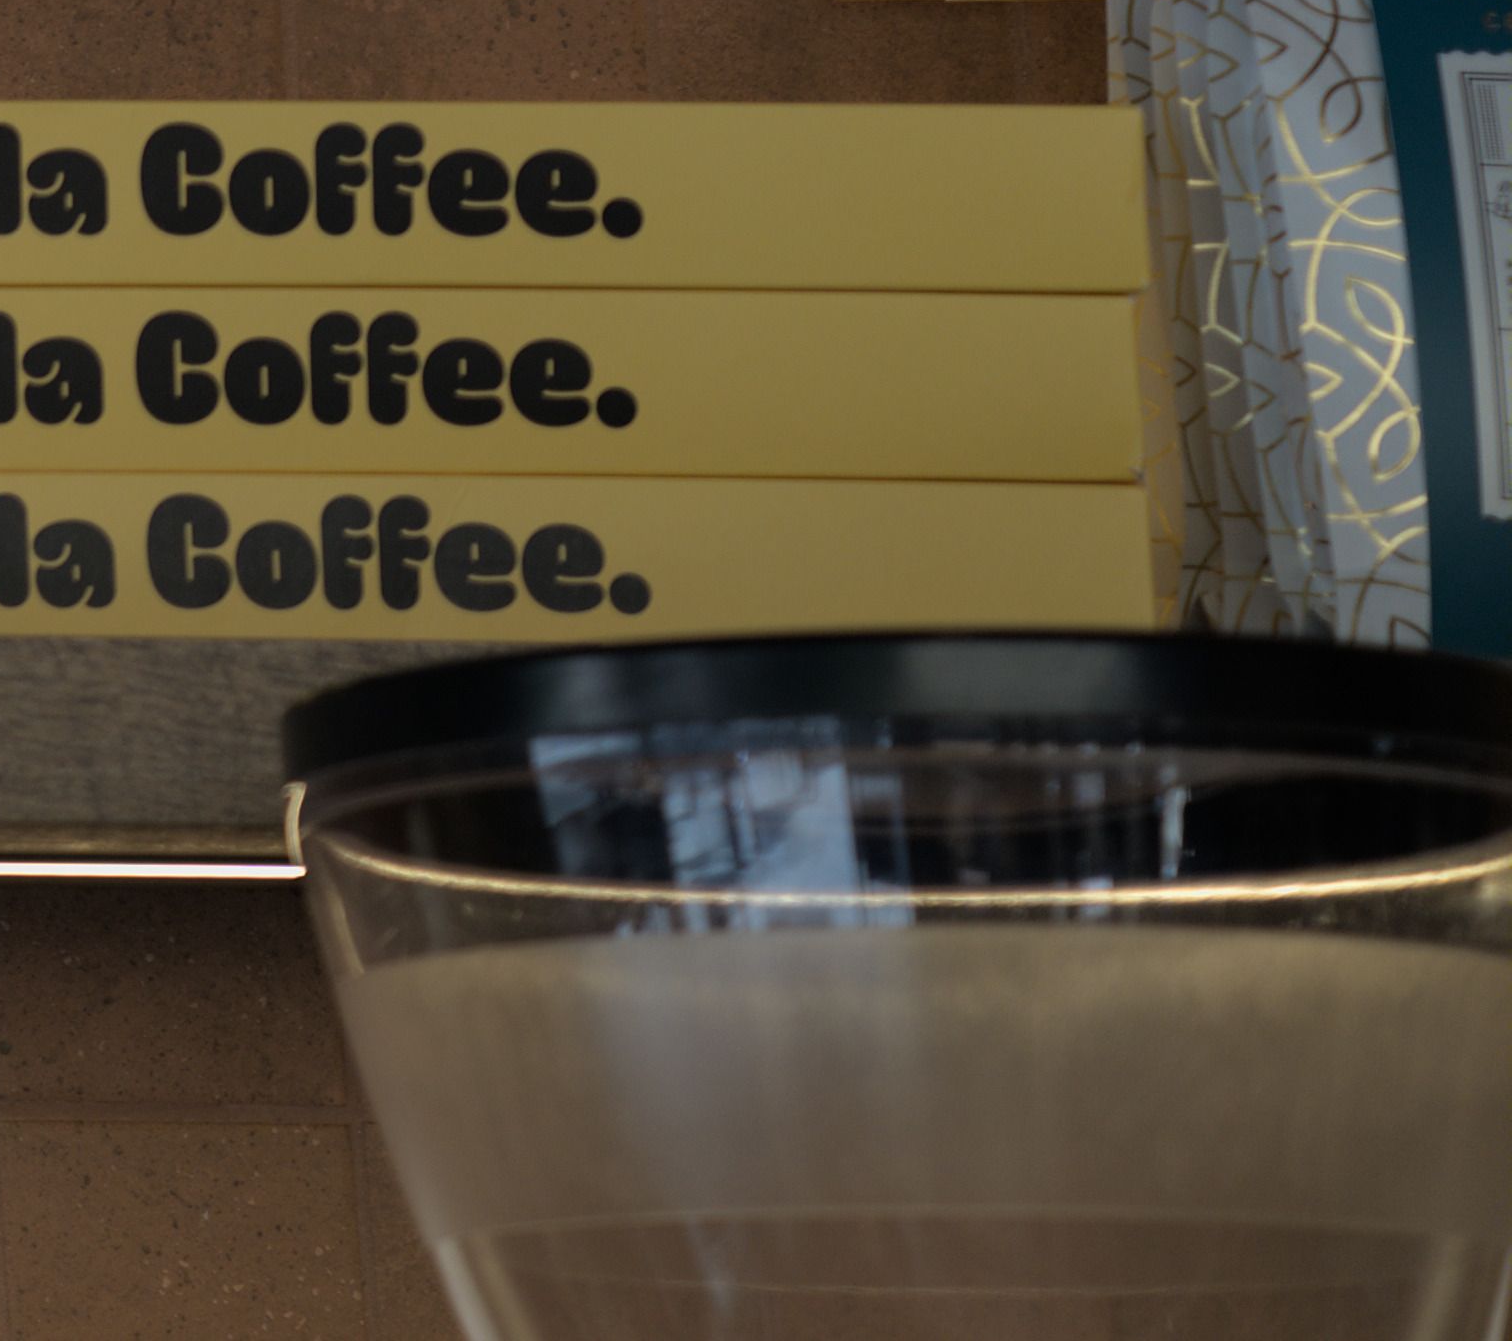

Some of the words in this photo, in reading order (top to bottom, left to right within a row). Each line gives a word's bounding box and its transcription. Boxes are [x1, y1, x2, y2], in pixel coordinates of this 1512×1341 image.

[140, 123, 643, 239] Coffee.
[136, 311, 637, 429] Coffee.
[147, 494, 651, 615] Coffee.
